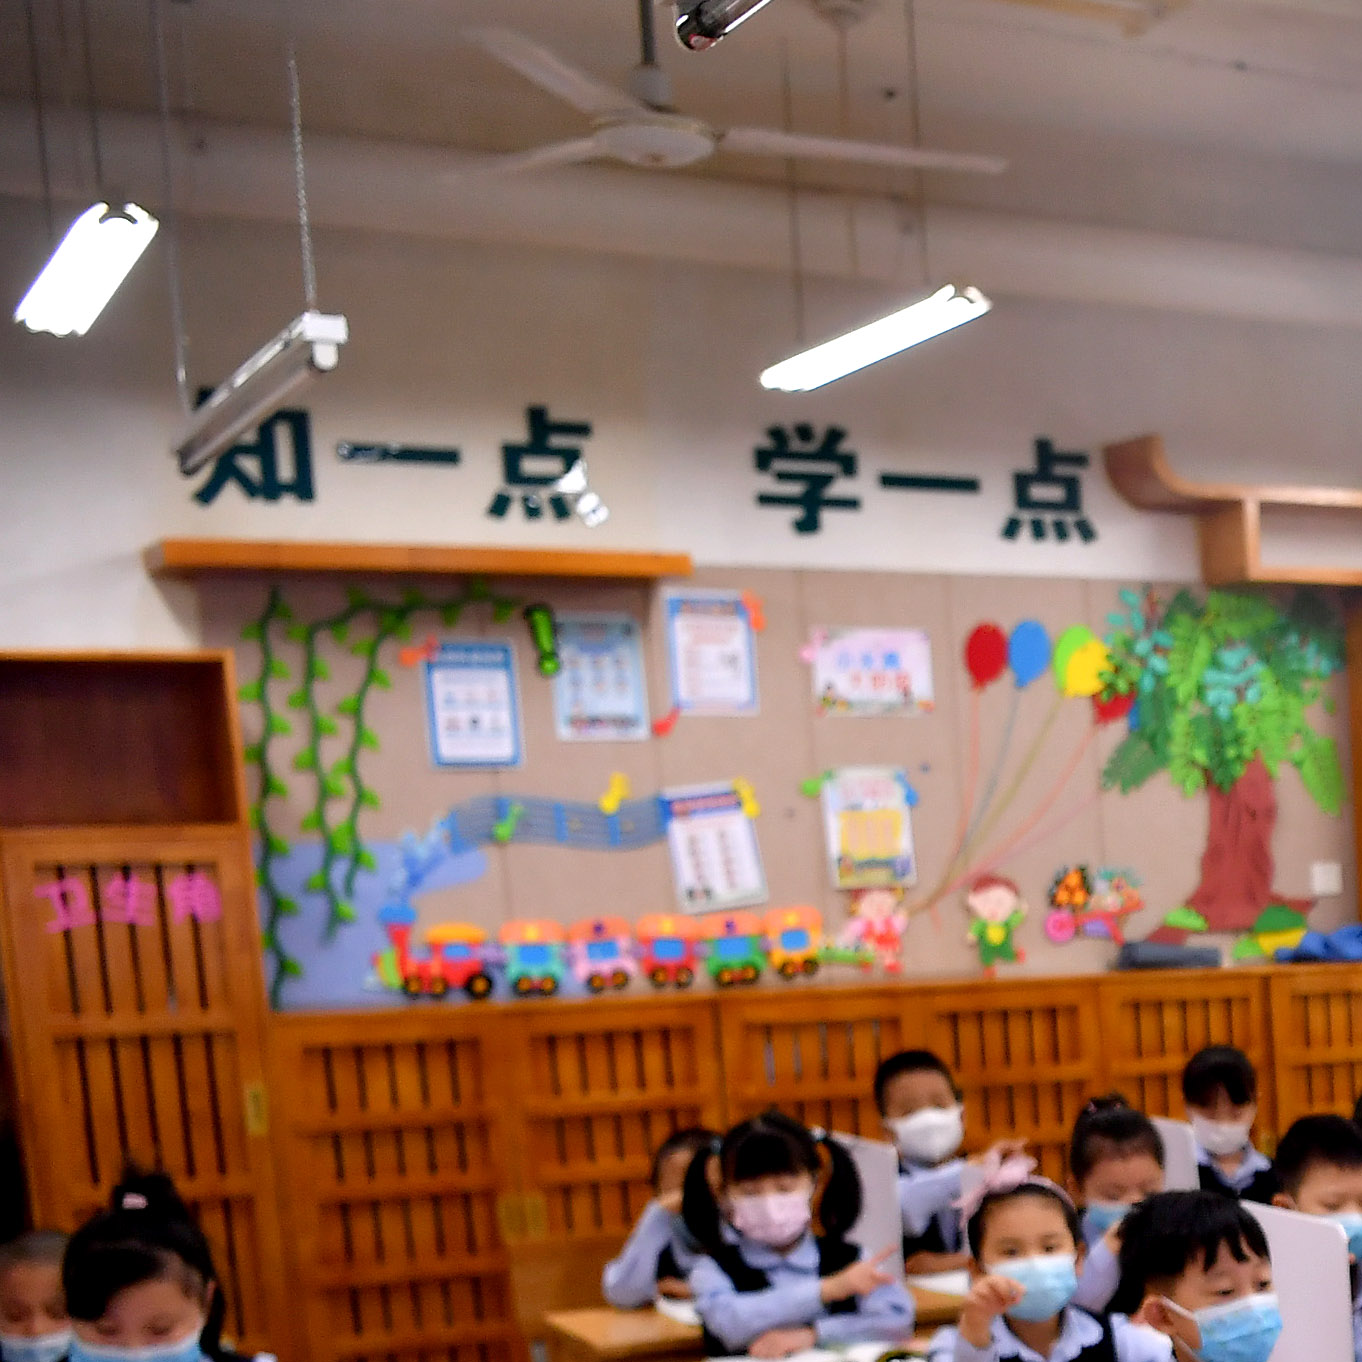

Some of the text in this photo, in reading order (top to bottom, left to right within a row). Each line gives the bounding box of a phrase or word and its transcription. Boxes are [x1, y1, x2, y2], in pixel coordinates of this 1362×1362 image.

[188, 387, 593, 520] 知一点
[753, 422, 1098, 544] 学一点
